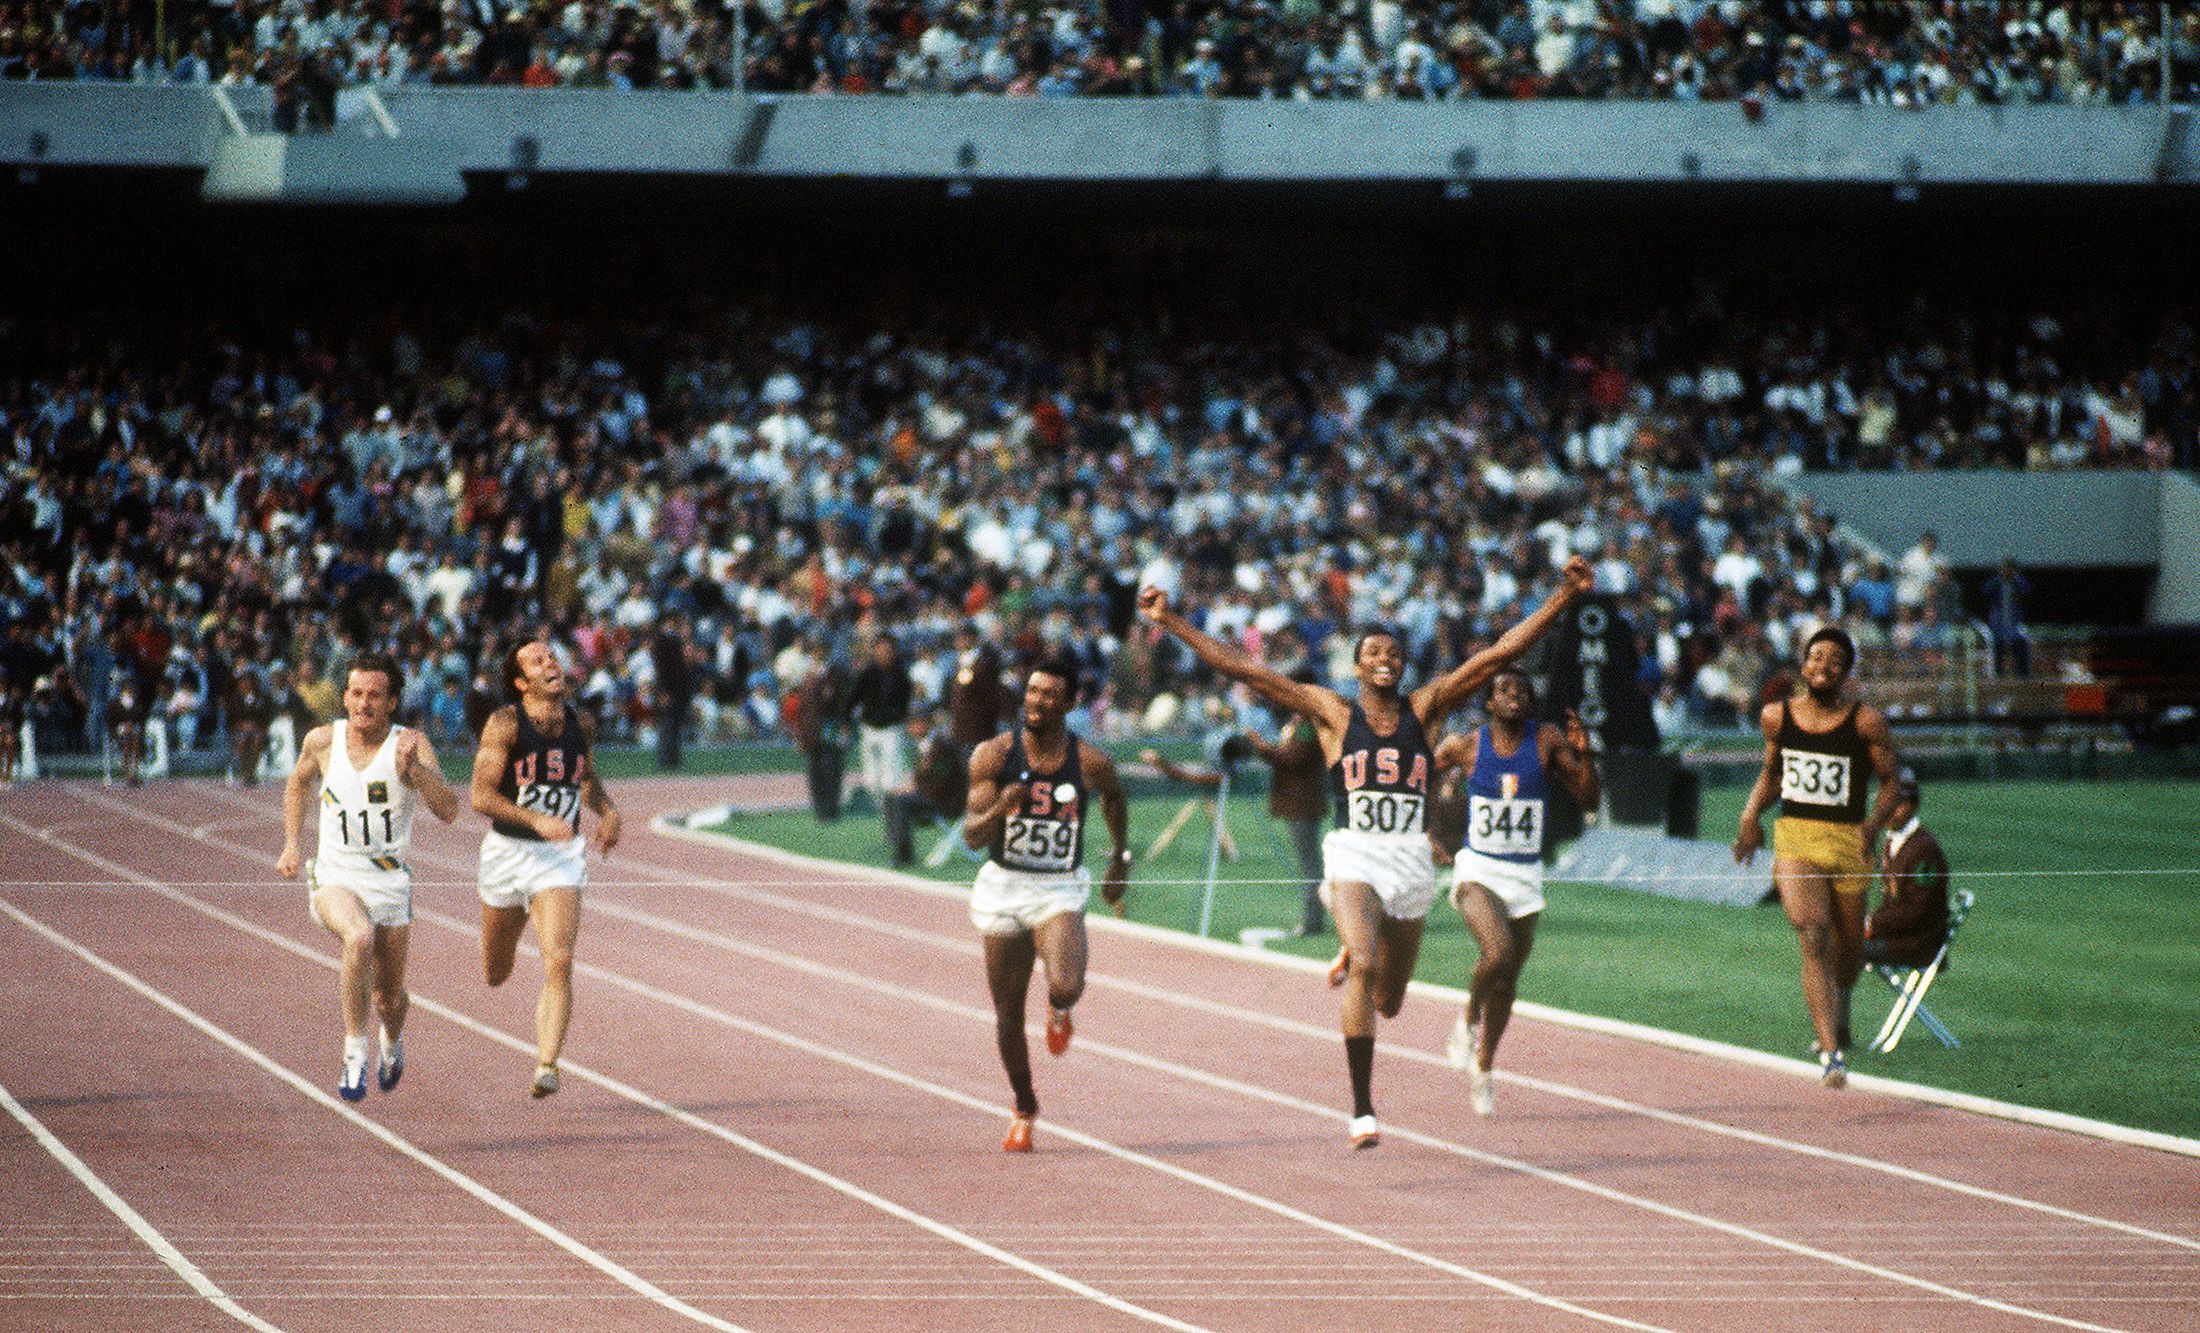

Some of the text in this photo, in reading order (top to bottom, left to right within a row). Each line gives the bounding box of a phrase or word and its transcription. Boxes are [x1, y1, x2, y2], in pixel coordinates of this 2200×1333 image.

[1340, 747, 1427, 793] USA
[1787, 755, 1844, 796] 533
[522, 784, 577, 818] 297
[1006, 780, 1078, 822] SA
[1355, 795, 1420, 833] 307
[338, 808, 393, 846] 111
[1006, 820, 1073, 859] 259
[1476, 804, 1535, 840] 344
